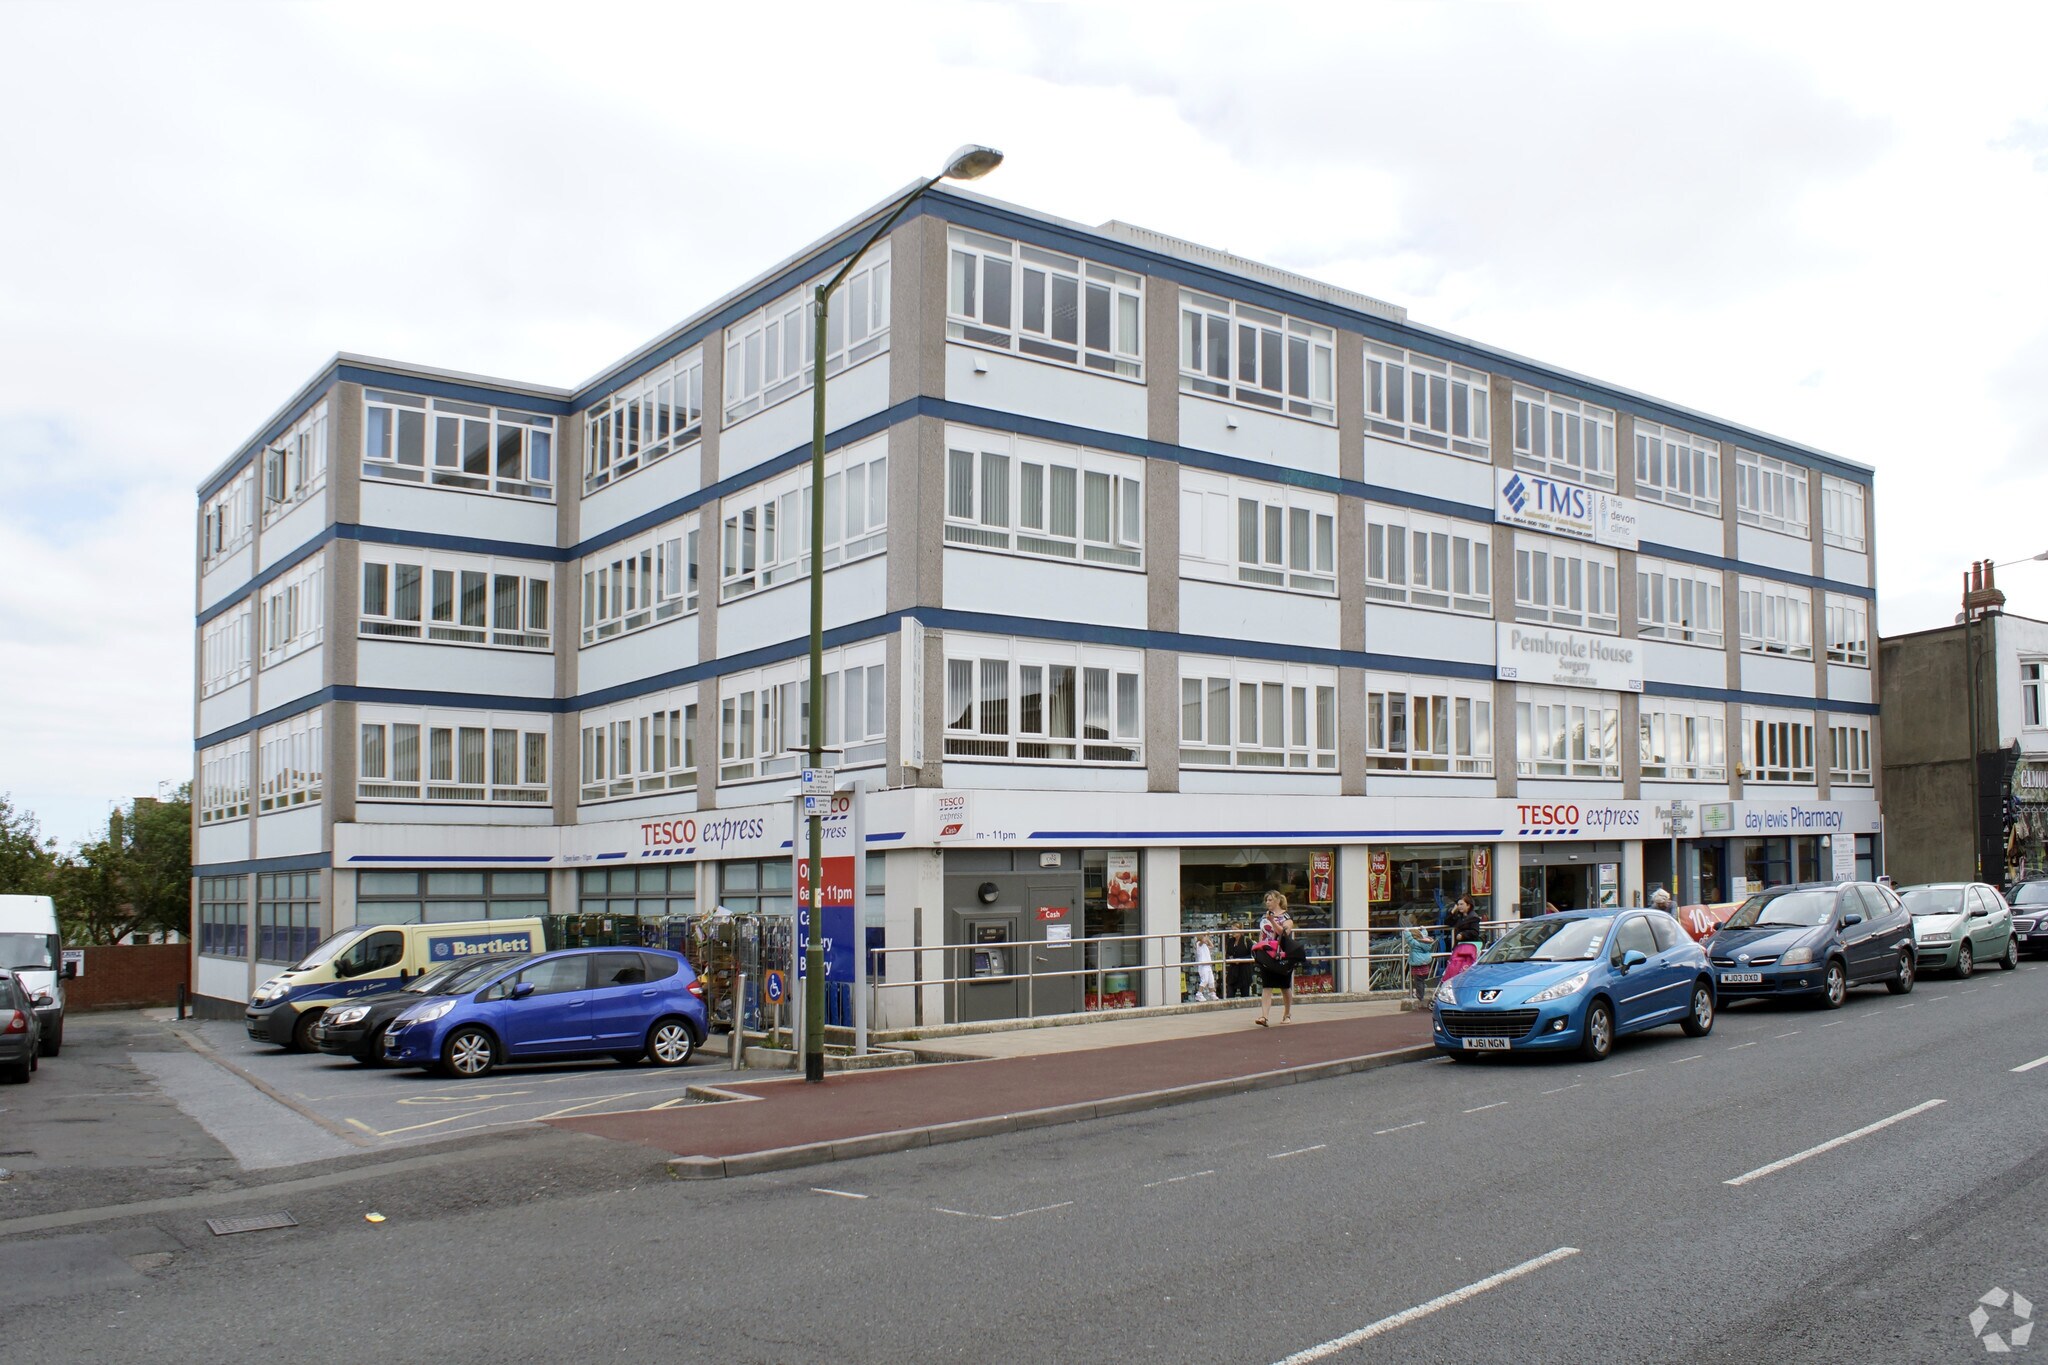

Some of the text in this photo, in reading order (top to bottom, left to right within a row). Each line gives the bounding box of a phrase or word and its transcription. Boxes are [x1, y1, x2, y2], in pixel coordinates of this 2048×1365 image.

[1532, 478, 1585, 519] TMS
[1611, 498, 1622, 508] the
[1611, 511, 1635, 524] devon
[1611, 523, 1630, 535] clinic
[1511, 629, 1633, 663] Pembroke House
[1502, 668, 1516, 677] NHS
[1558, 657, 1591, 675] Surgery
[1629, 680, 1641, 689] NHS
[939, 796, 964, 807] TESCO
[940, 812, 963, 822] express
[1517, 804, 1640, 832] TESCO express
[1656, 804, 1694, 819] Pemoke
[1745, 807, 1843, 832] day lewis Pharmacy
[641, 817, 764, 850] TESCO express
[945, 827, 957, 835] Cash
[993, 830, 1016, 841] 11pm
[1476, 849, 1486, 865] £1
[1314, 861, 1330, 869] FREE
[800, 864, 823, 881] On
[800, 886, 810, 900] 6a
[827, 885, 852, 903] 11pm
[1045, 910, 1060, 918] Cash
[452, 938, 529, 956] Bartlett
[1467, 1038, 1505, 1048] WJ61 NGN
